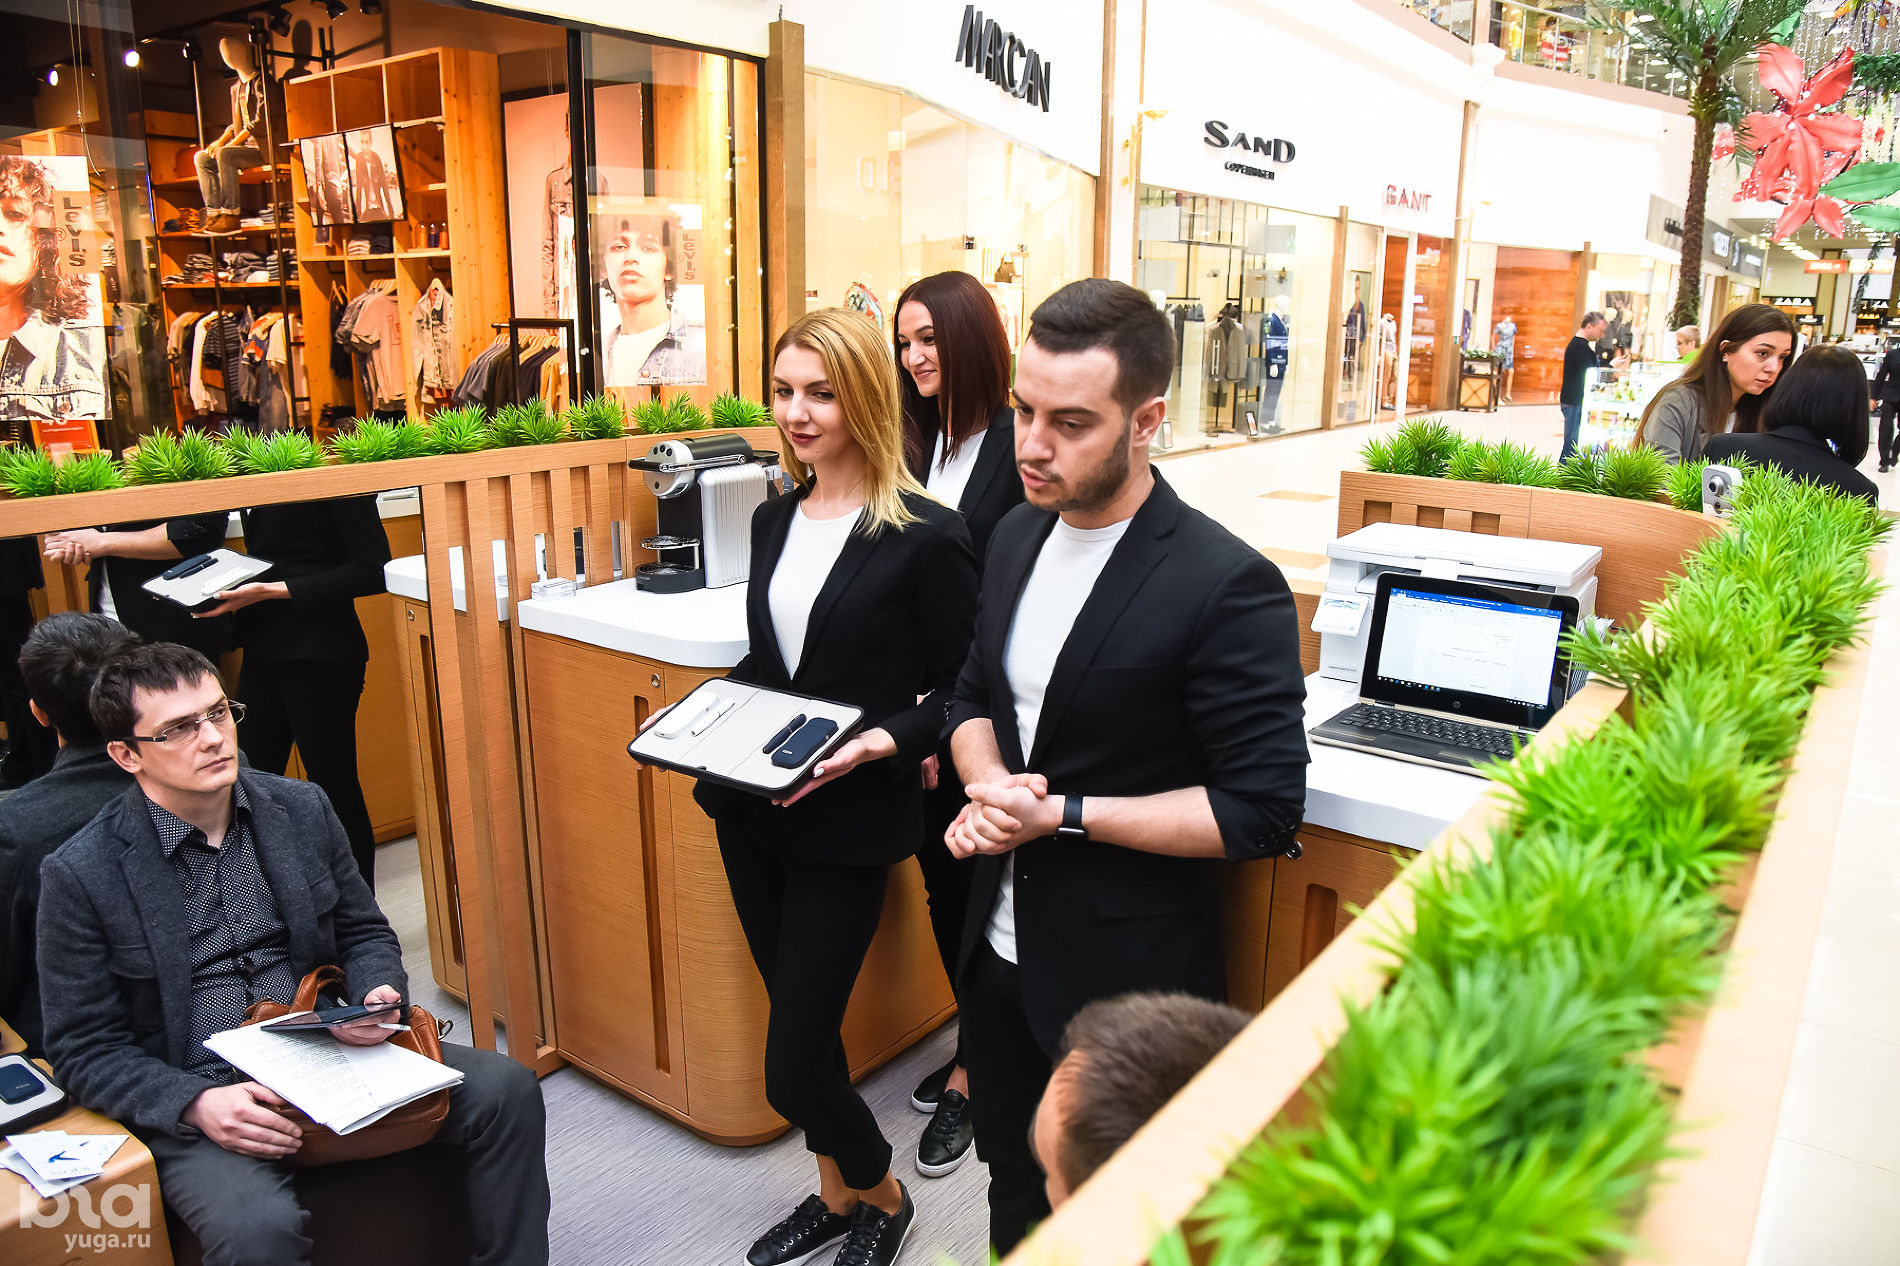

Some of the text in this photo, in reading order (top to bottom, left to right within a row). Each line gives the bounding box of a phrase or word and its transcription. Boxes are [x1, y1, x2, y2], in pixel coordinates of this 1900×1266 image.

[1203, 120, 1296, 163] SAND
[1386, 184, 1432, 213] GANT
[1774, 297, 1812, 306] ZARA
